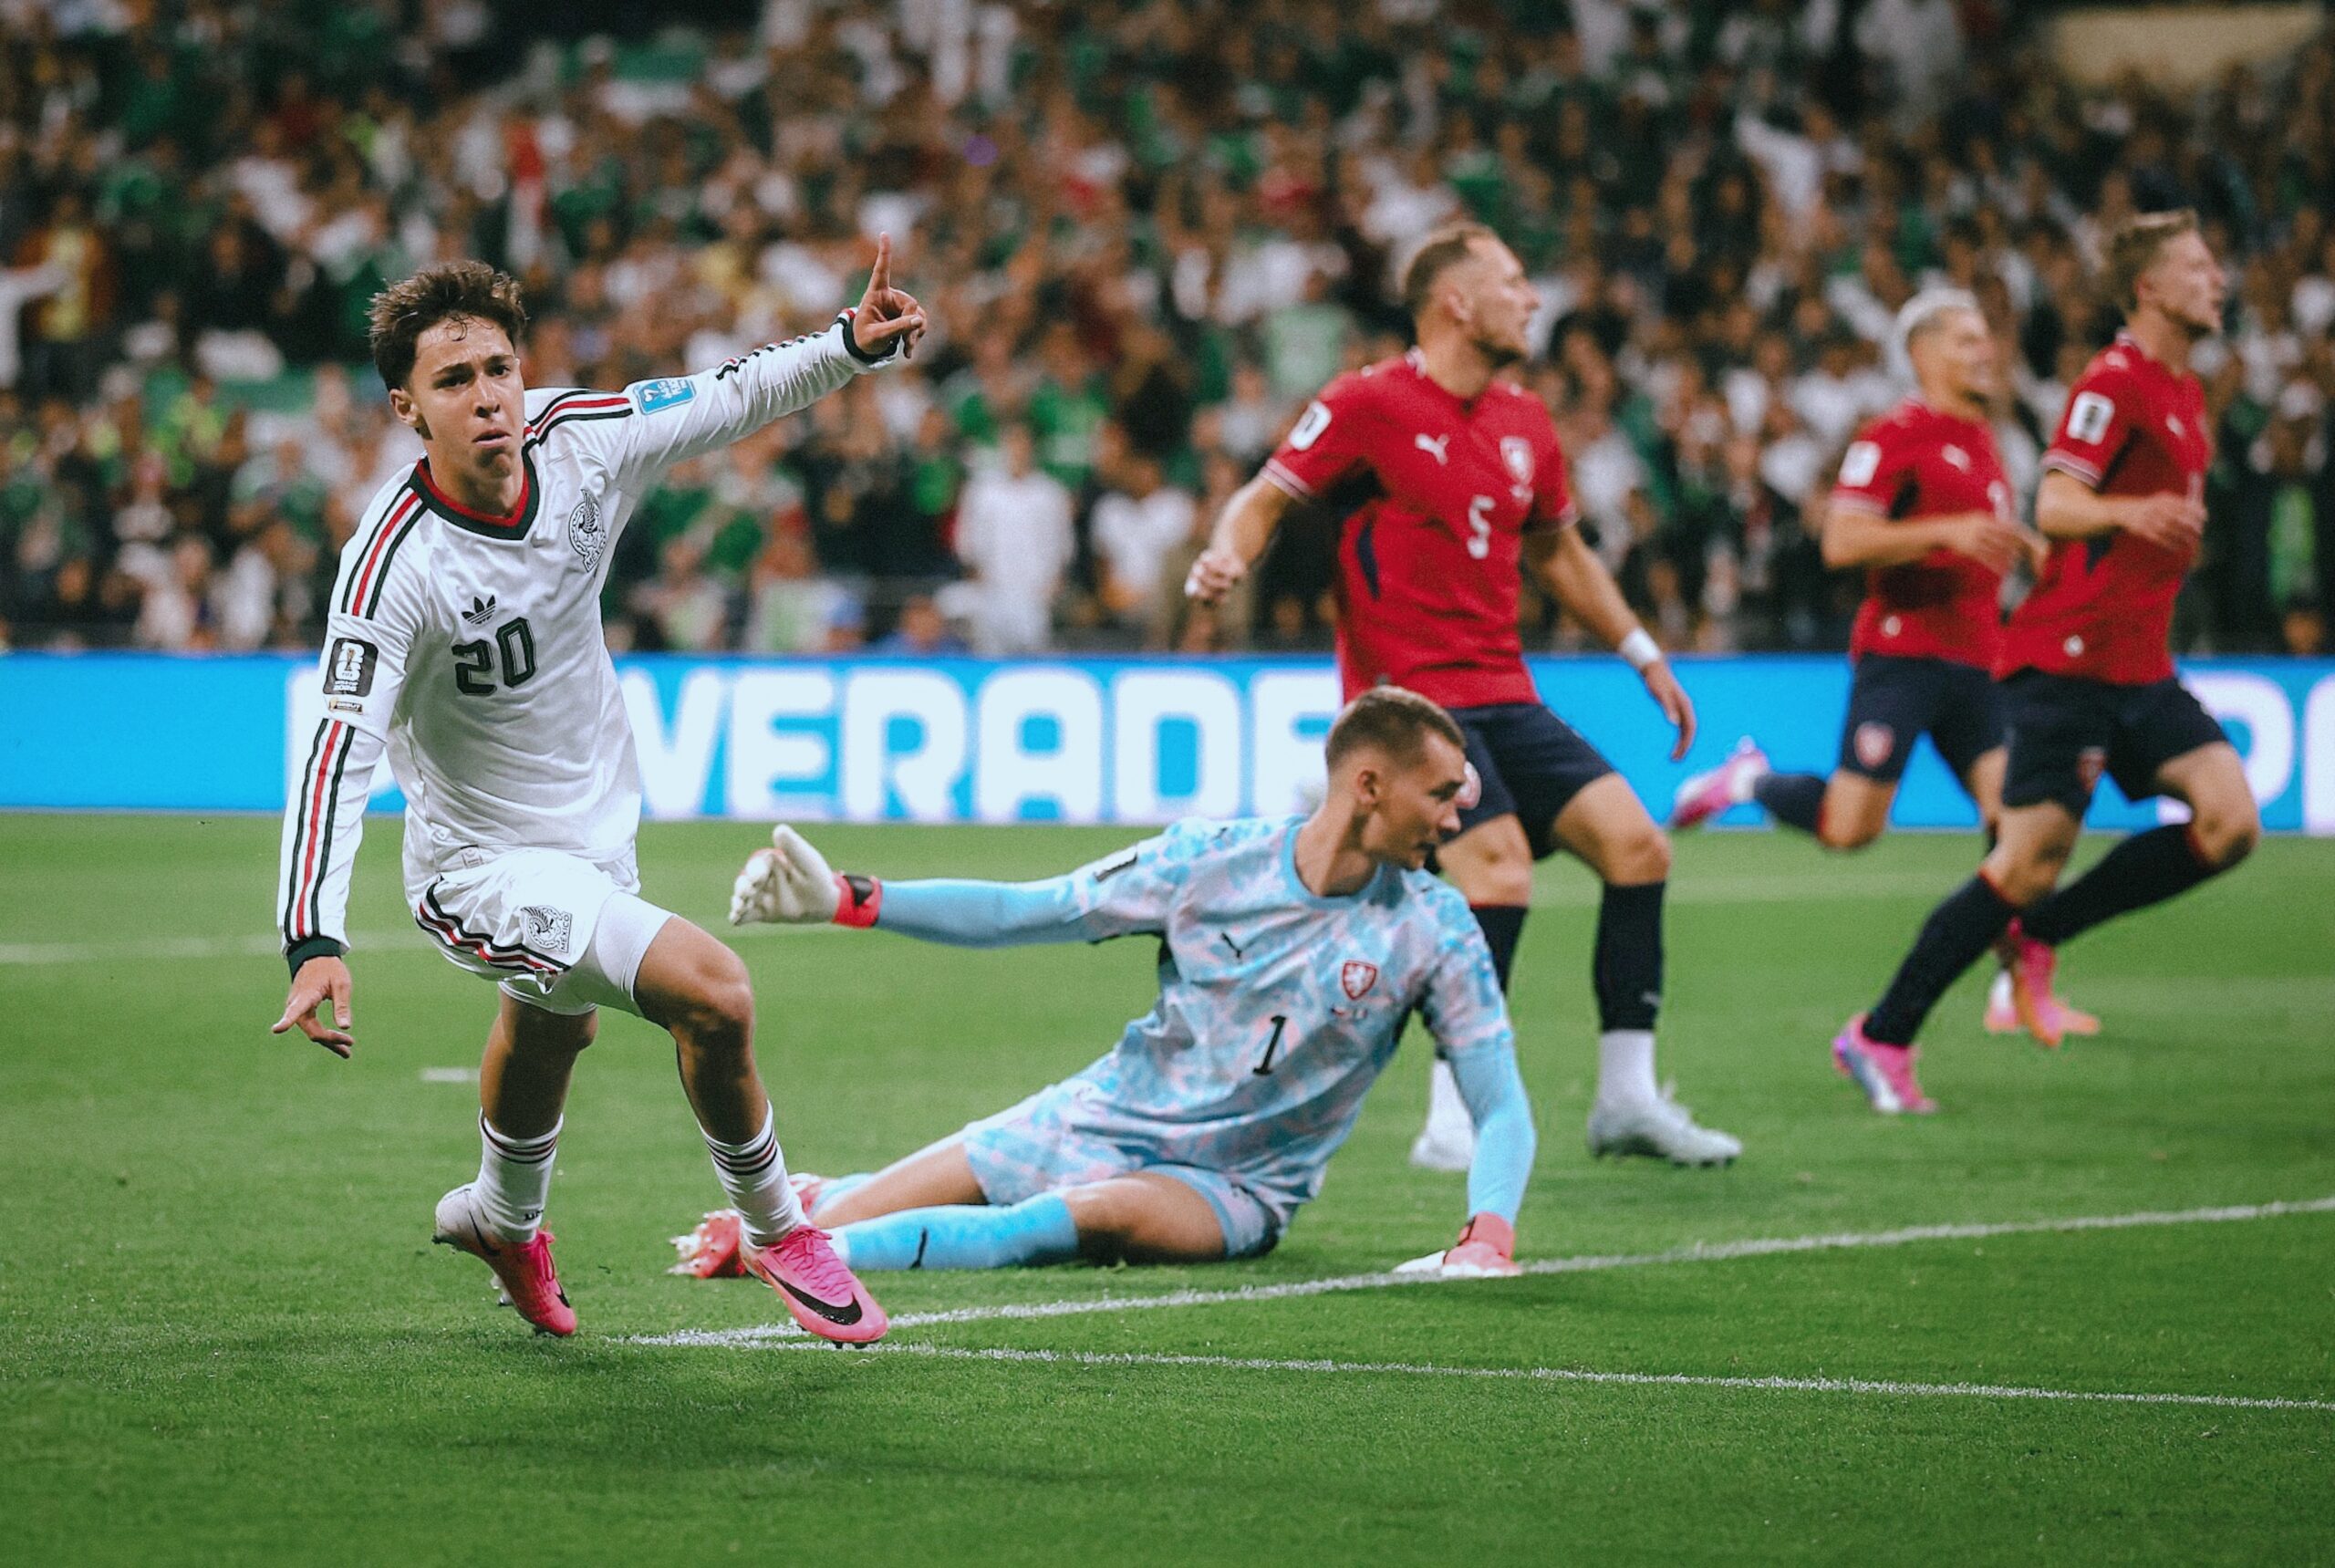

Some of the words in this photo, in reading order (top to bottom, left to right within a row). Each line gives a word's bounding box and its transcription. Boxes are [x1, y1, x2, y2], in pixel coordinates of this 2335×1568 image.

[1467, 495, 1497, 560] 5
[451, 617, 538, 697] 20
[1253, 1015, 1287, 1075] 1
